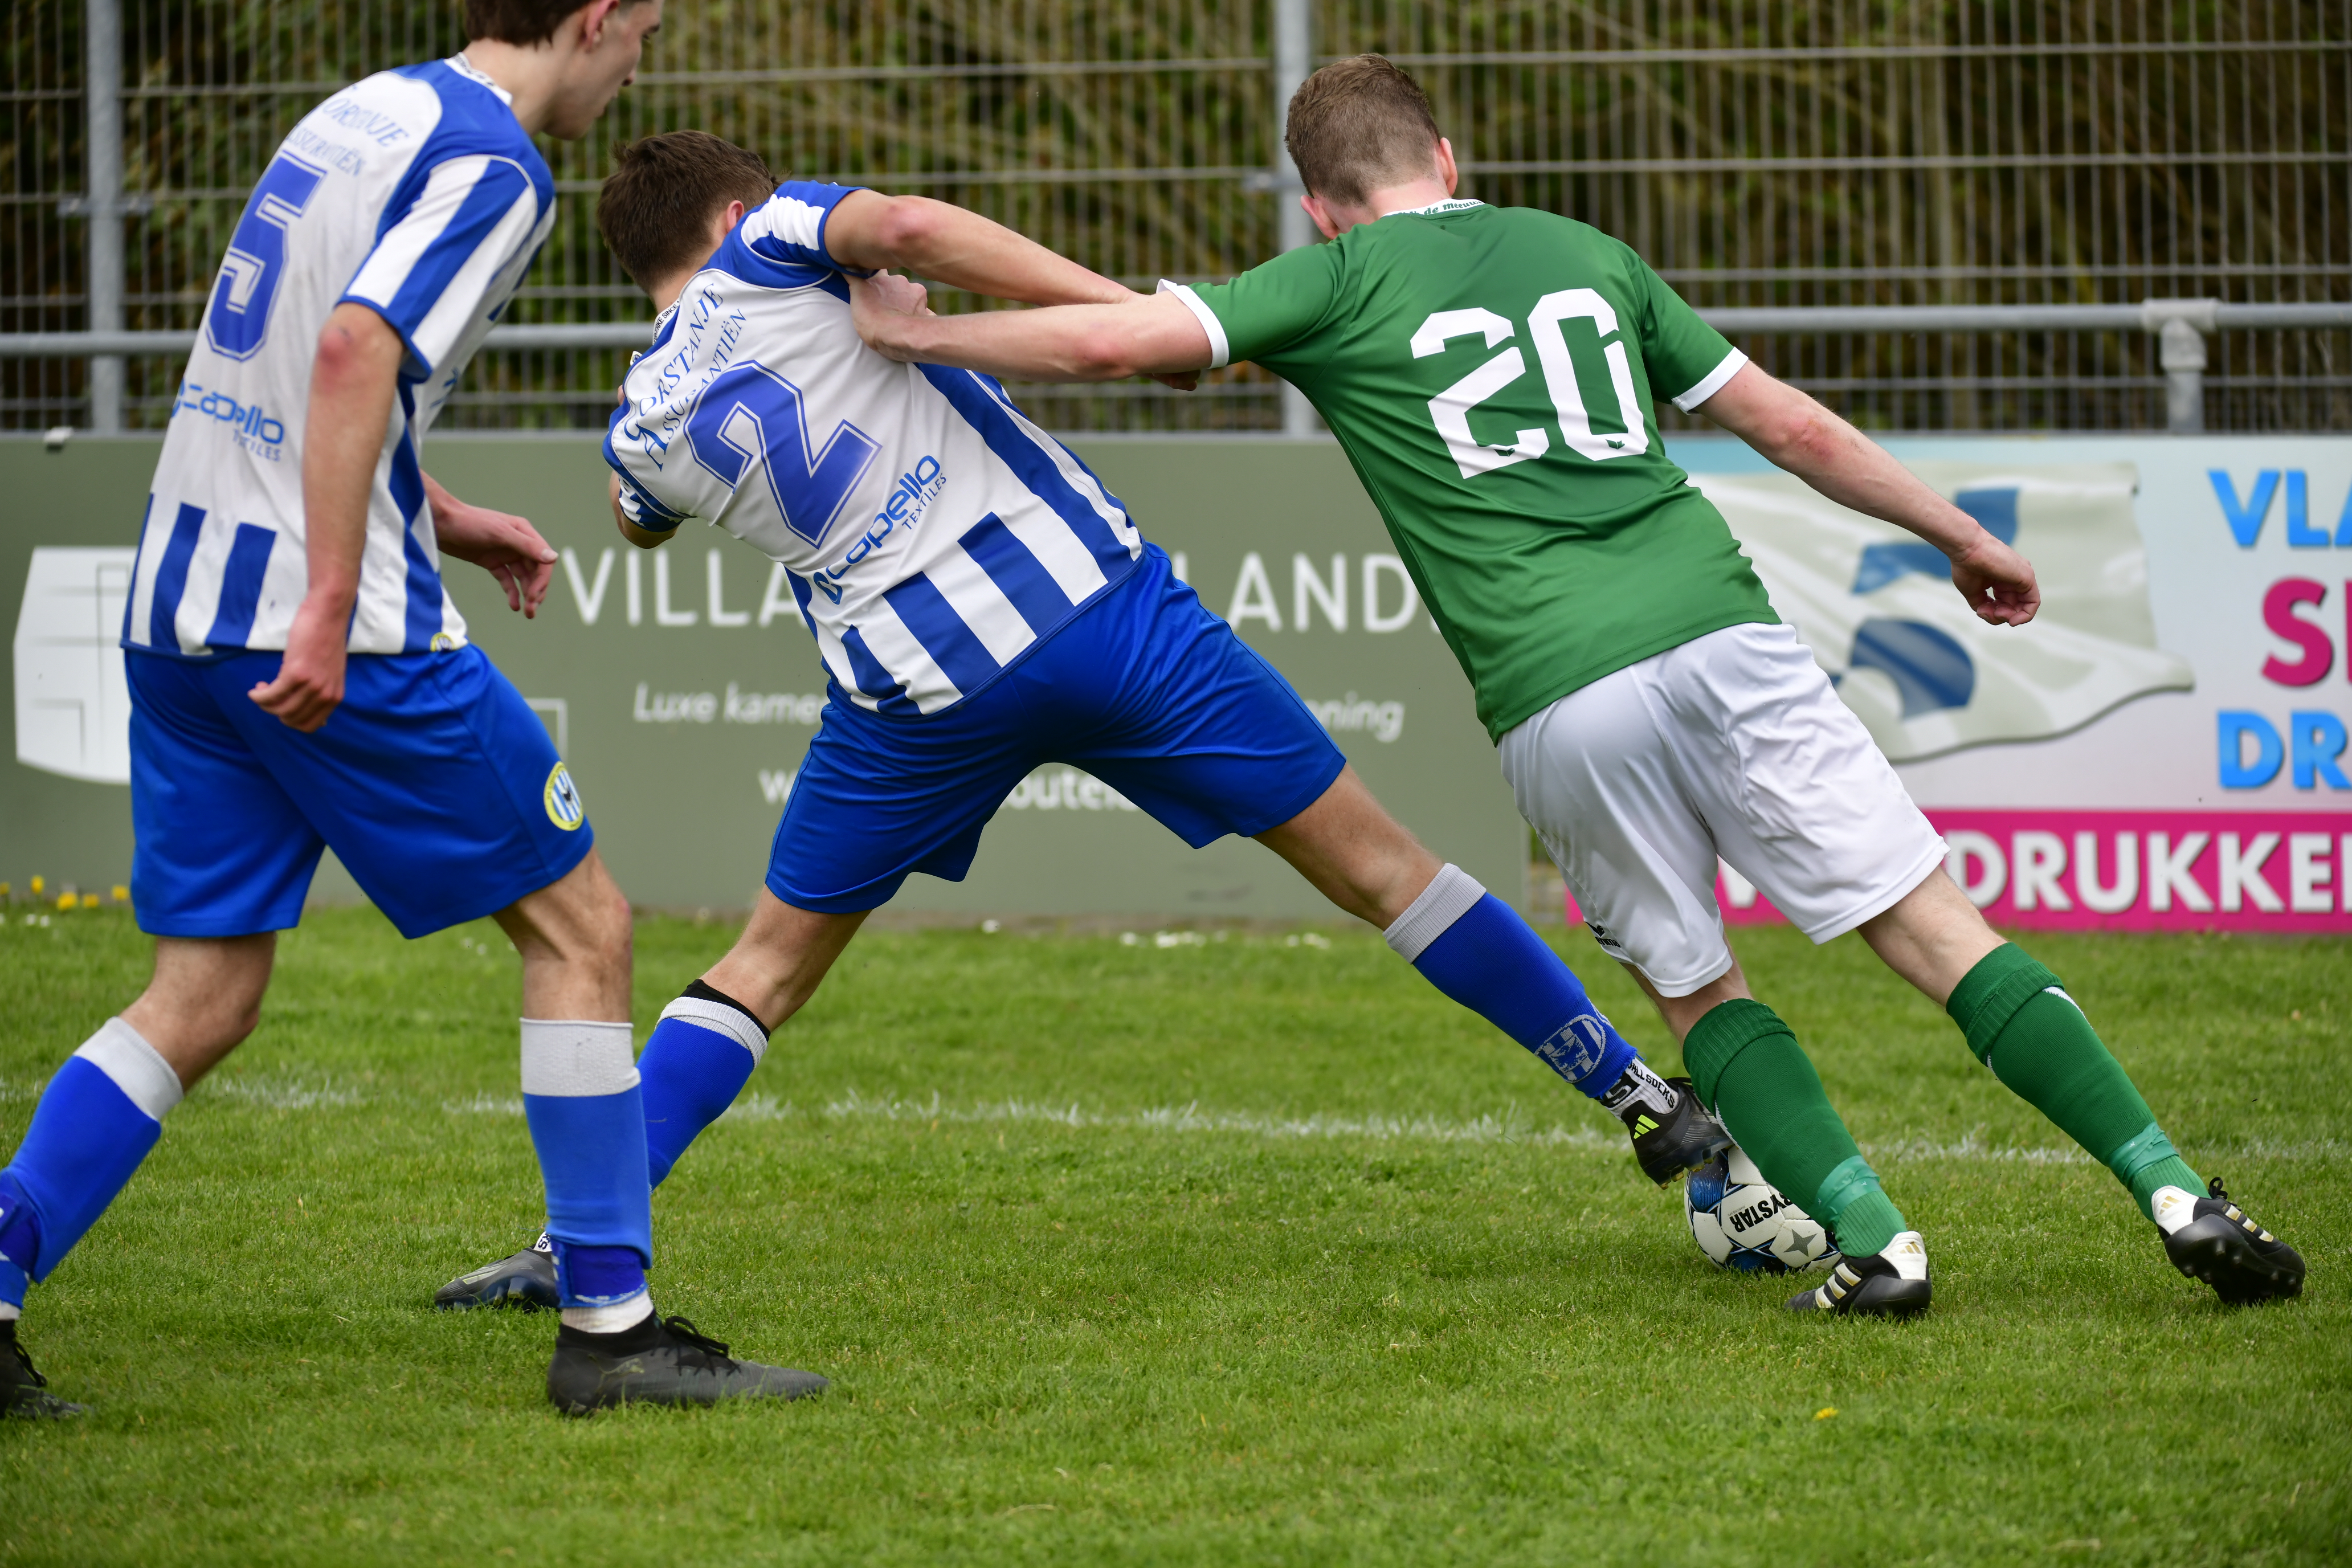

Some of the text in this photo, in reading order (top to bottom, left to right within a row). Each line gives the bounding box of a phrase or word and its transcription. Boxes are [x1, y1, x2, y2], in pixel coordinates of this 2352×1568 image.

[205, 149, 328, 363] 5
[662, 304, 678, 319] SINCE
[1410, 288, 1649, 480] 20
[684, 360, 883, 550] 2
[901, 472, 946, 530] TEXTILES
[633, 681, 718, 725] Luxe
[1943, 830, 2352, 914] DRUKKE
[1645, 1073, 1675, 1109] SOCKS
